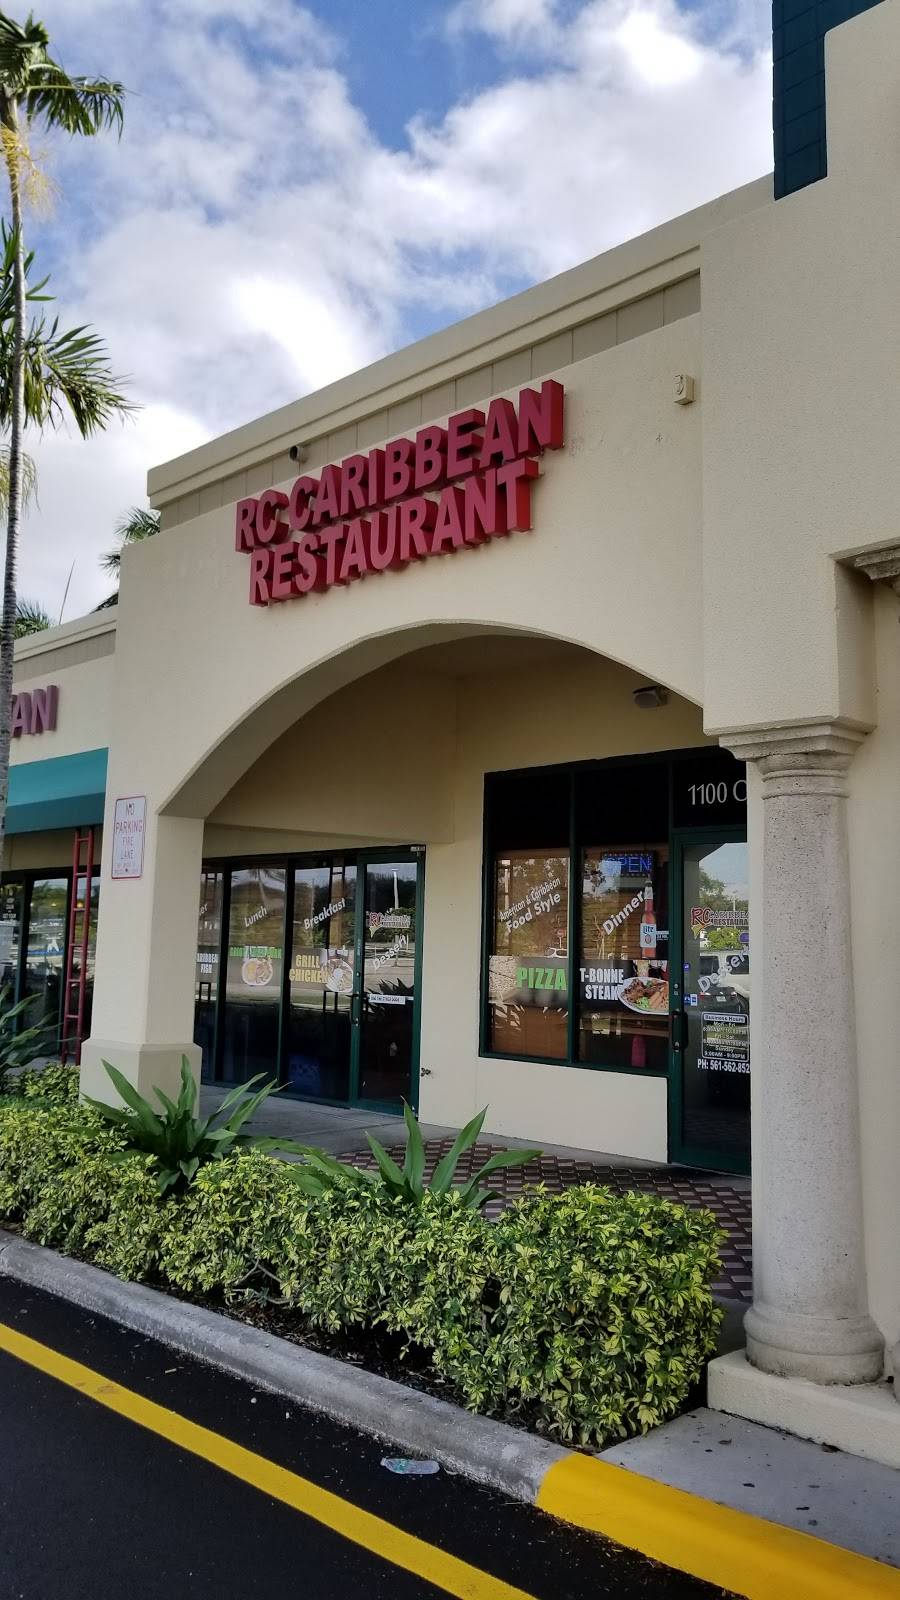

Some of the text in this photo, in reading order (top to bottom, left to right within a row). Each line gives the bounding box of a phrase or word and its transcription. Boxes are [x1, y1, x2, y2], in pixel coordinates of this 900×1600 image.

[236, 379, 564, 553] RC CARIBBEAN
[250, 457, 539, 607] RESTAURANT
[11, 685, 59, 738] AN
[688, 782, 727, 805] 1100
[126, 803, 135, 816] NO
[115, 820, 143, 833] PARKING
[122, 836, 134, 847] FIRE
[120, 849, 134, 860] LANE
[606, 856, 652, 873] OPEN
[500, 898, 526, 922] American
[530, 877, 561, 901] Caribbean
[244, 905, 267, 928] Lunch
[303, 898, 346, 930] Breakfast
[505, 893, 561, 934] Food Style
[602, 890, 644, 935] Dinner
[691, 907, 748, 926] RC CARIBBEA
[642, 925, 654, 934] Lite
[296, 954, 321, 968] GRILL
[373, 935, 407, 970] Dessert
[289, 968, 329, 984] CHICKEN
[517, 967, 567, 991] PIZZA
[580, 968, 624, 984] T-BONNE
[698, 944, 749, 993] Dessert
[585, 985, 619, 1001] STEAK
[697, 1059, 750, 1073] PH: 561-562-852
